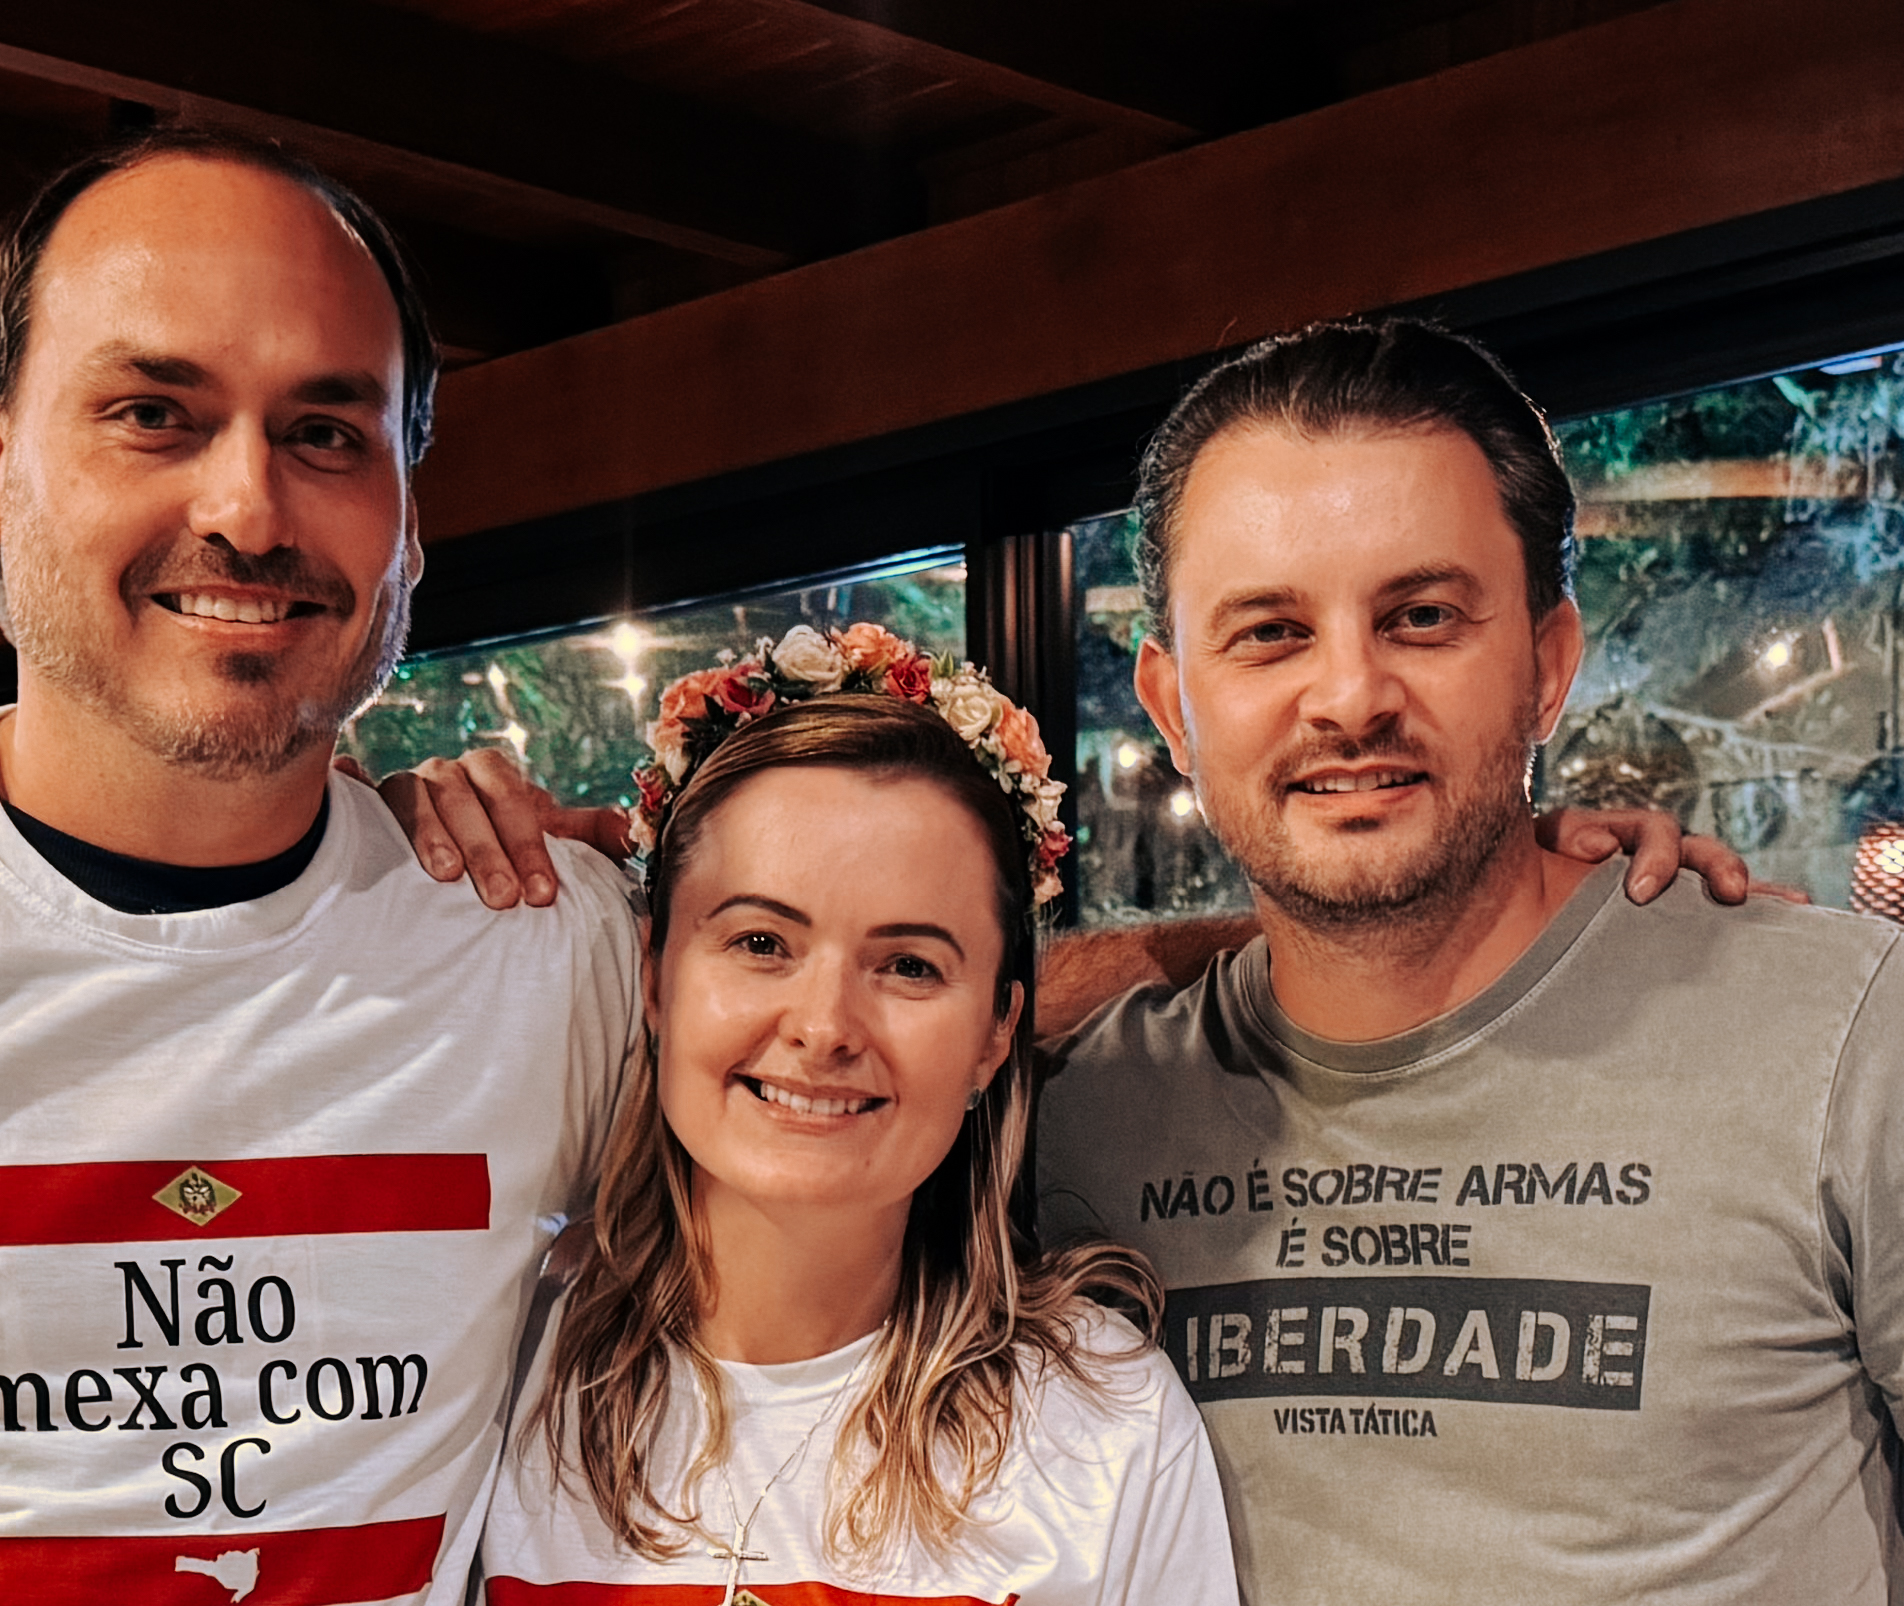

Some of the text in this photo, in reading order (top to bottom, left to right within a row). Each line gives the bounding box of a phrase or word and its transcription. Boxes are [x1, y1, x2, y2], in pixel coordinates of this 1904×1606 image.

[1140, 1158, 1652, 1222] NÃO É SOBRE ARMAS
[1276, 1217, 1472, 1268] É SOBRE
[114, 1255, 295, 1349] Não
[1186, 1306, 1639, 1387] IBERDADE
[259, 1354, 427, 1424] com
[1274, 1402, 1438, 1437] VISTA TÁTICA
[162, 1438, 270, 1518] SC
